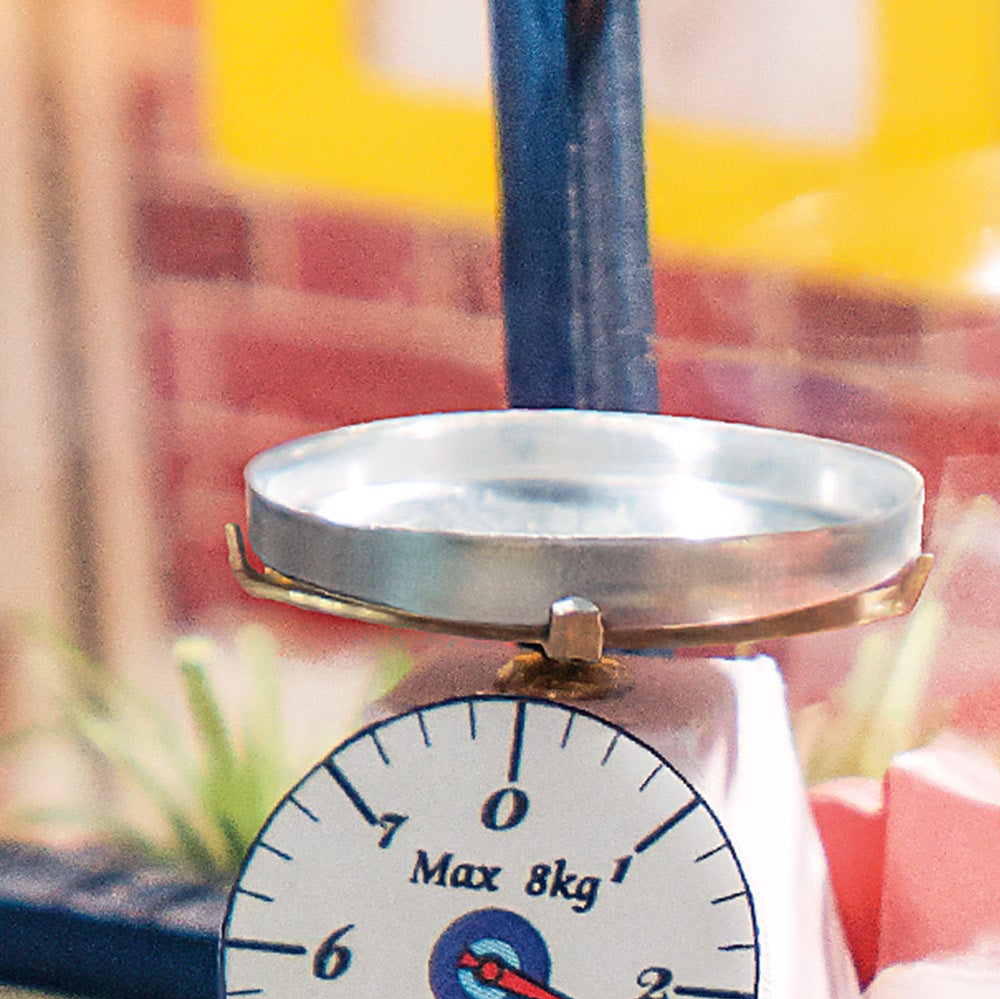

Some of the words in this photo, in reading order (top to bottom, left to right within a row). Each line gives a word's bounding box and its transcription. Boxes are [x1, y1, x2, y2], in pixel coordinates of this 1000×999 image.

[481, 787, 530, 830] 0
[377, 812, 409, 849] 7
[409, 849, 502, 892] Max
[525, 860, 602, 914] 8kg
[610, 855, 634, 883] 1
[312, 924, 355, 980] 6
